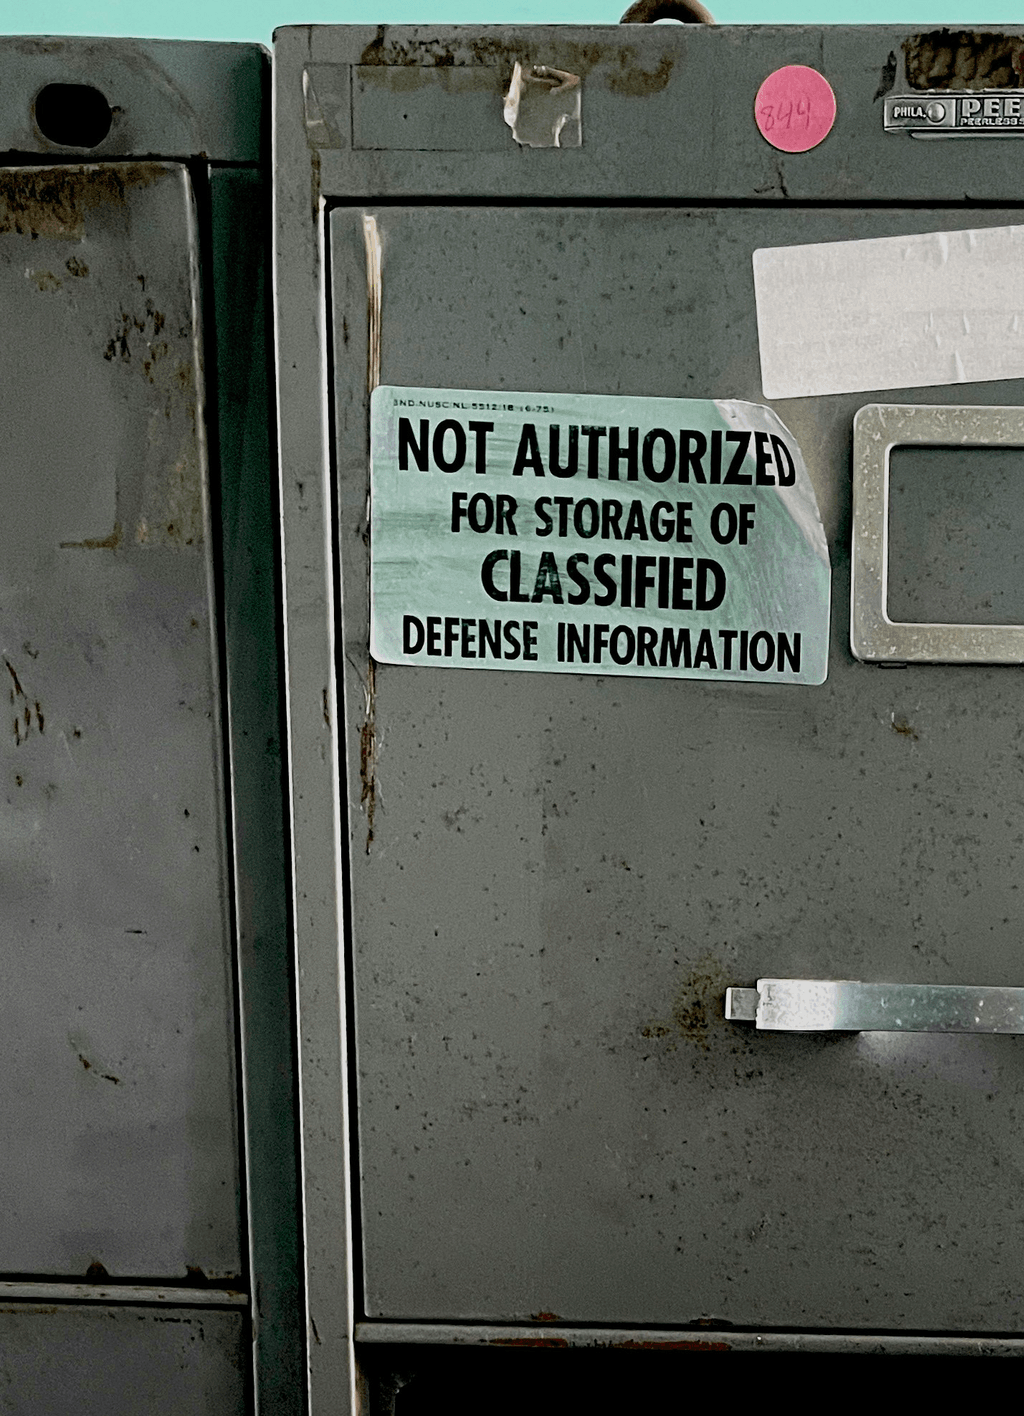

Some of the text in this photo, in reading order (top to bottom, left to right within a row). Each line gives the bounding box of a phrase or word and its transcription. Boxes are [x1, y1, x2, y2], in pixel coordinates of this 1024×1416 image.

[893, 106, 927, 119] PHILA.
[960, 117, 1018, 126] PEERLESS
[399, 417, 796, 487] NOT AUTHORIZED
[451, 492, 756, 545] FOR STORAGE OF
[481, 549, 726, 611] CLASSIFIED
[402, 615, 801, 673] DEFENSE INFORMATION
